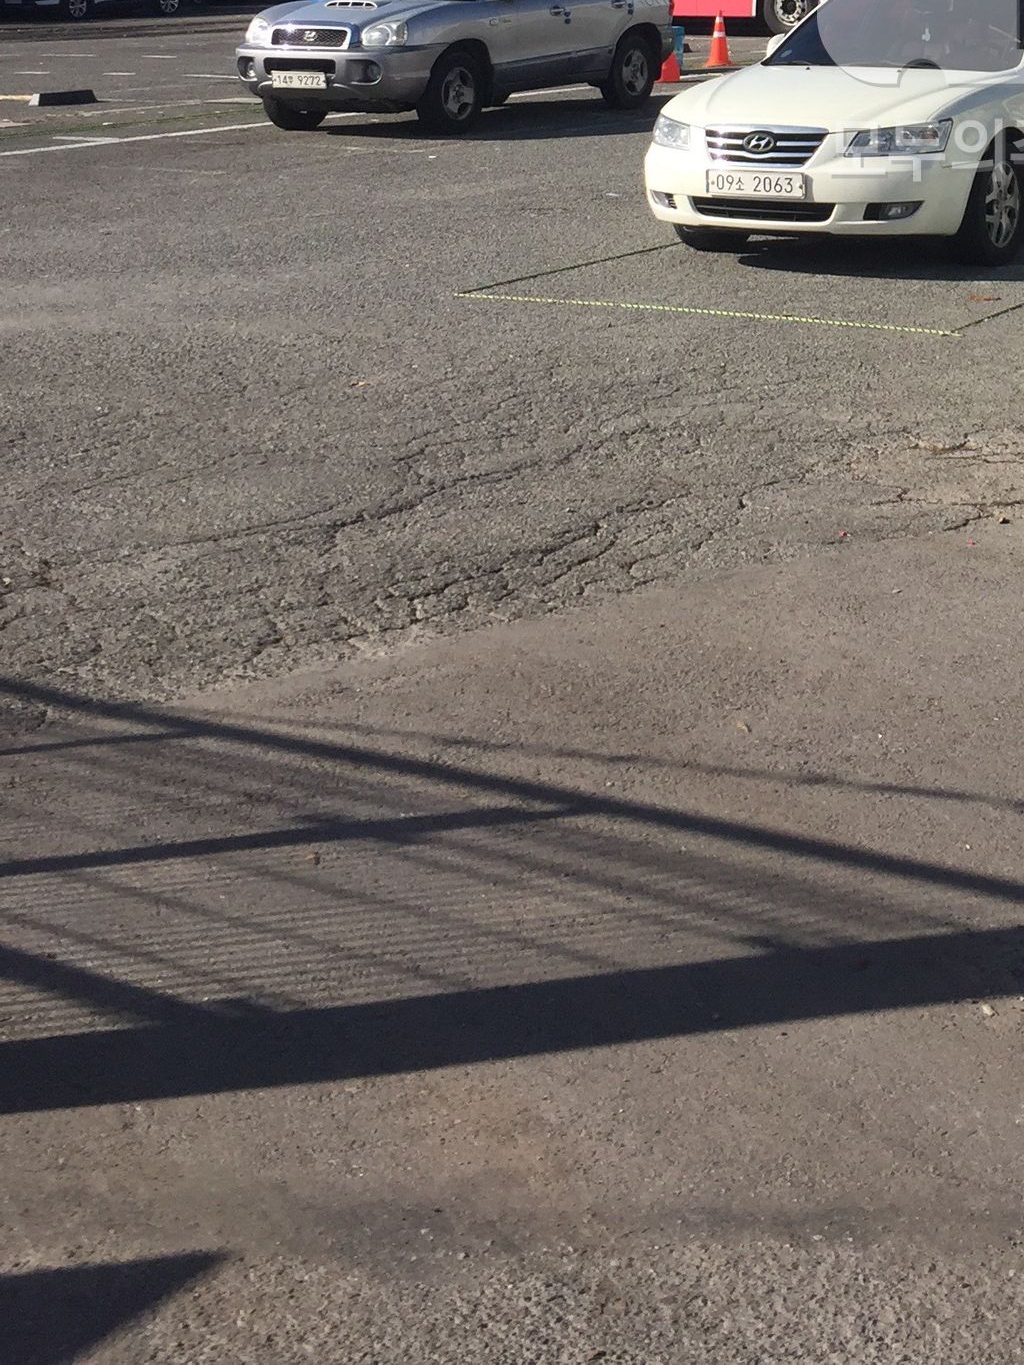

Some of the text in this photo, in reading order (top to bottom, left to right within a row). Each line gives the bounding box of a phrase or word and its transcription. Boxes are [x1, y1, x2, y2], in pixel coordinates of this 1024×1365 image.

[297, 75, 321, 86] 9272
[716, 174, 793, 193] 09소 2063
